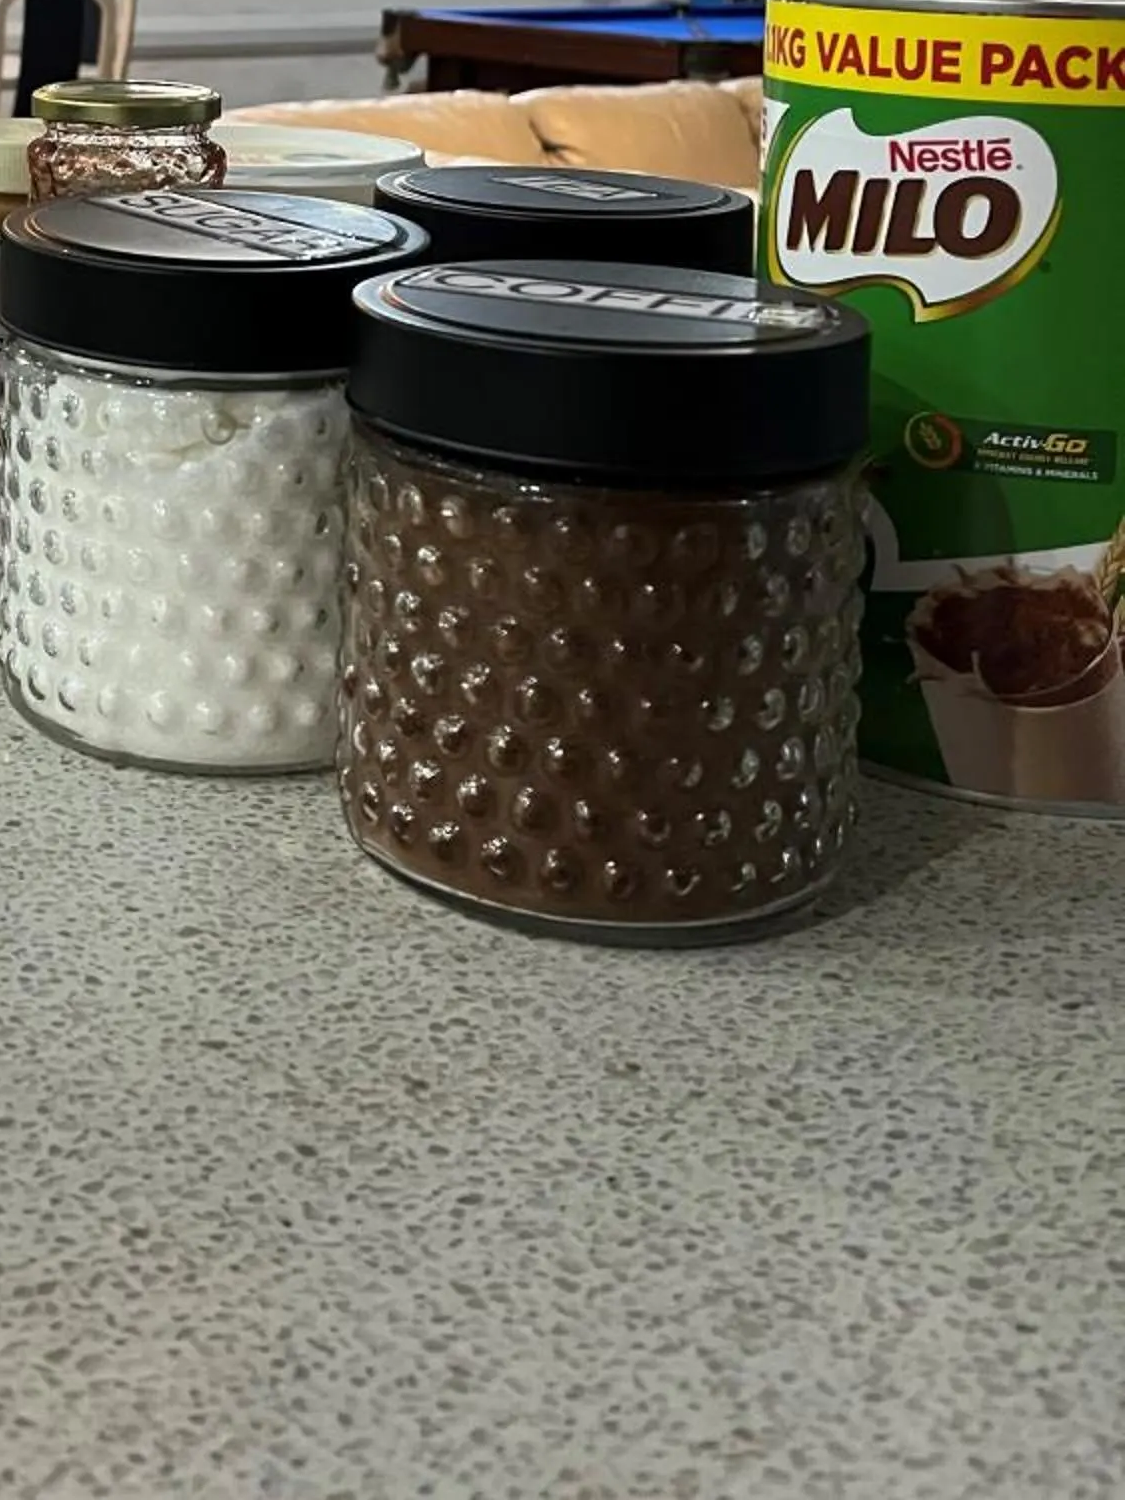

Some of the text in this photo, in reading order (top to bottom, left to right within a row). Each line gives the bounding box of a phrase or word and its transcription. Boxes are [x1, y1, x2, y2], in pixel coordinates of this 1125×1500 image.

[816, 31, 962, 83] VALUE
[979, 43, 1125, 91] PACK
[889, 138, 1013, 173] Nestlé
[786, 169, 1022, 259] MILO
